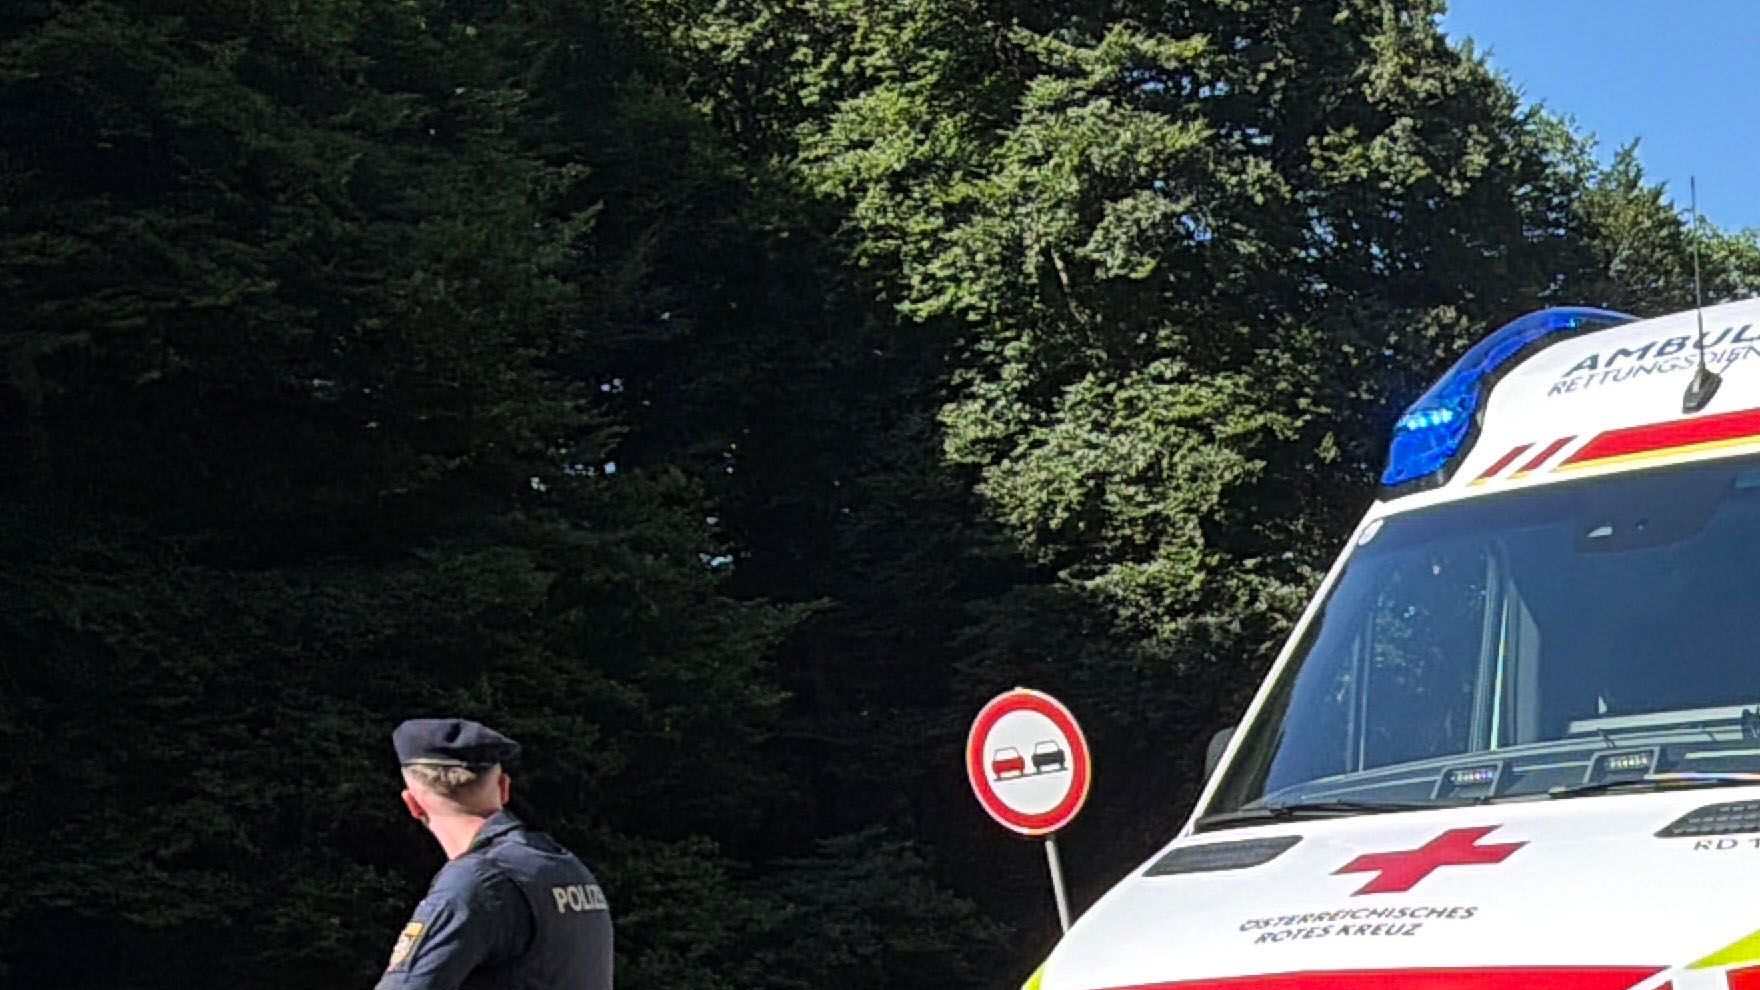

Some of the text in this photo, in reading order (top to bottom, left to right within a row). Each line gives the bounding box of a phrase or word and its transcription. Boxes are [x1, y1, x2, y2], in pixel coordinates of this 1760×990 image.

[1693, 838, 1739, 850] RD
[1254, 923, 1424, 945] ROTES KREUZ
